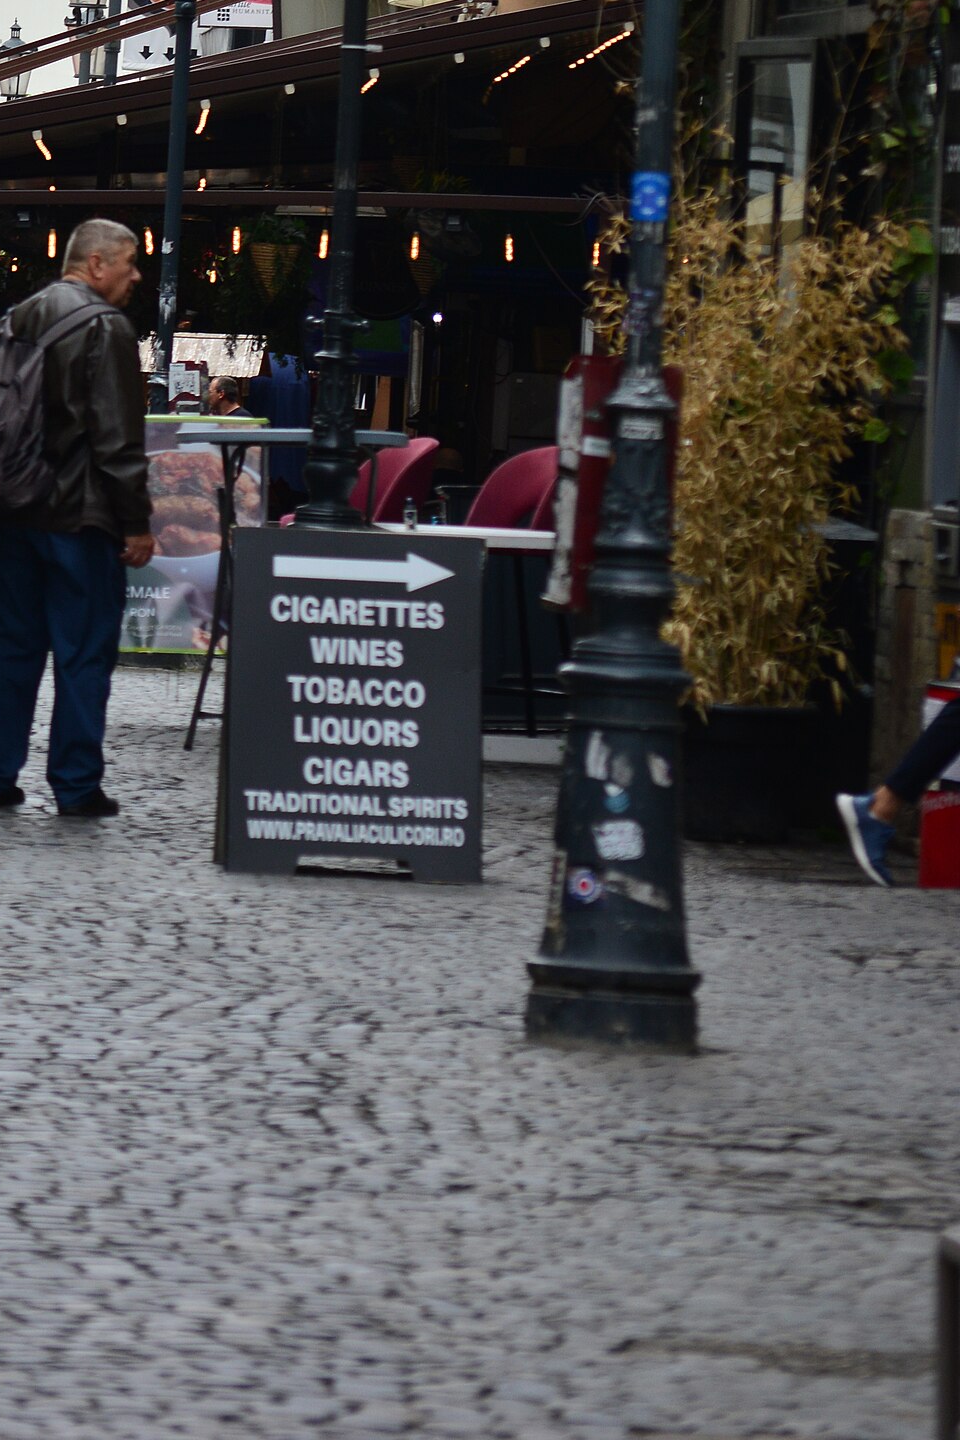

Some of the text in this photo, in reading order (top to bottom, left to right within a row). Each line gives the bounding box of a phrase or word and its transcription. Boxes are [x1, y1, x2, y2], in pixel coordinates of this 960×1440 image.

[270, 594, 445, 630] CIGARETTES
[310, 636, 404, 668] WINES
[287, 675, 426, 709] TOBACCO
[294, 715, 419, 748] LIQUORS
[303, 757, 409, 788] CIGARS
[244, 790, 469, 820] TRADITIONAL SPIRITS
